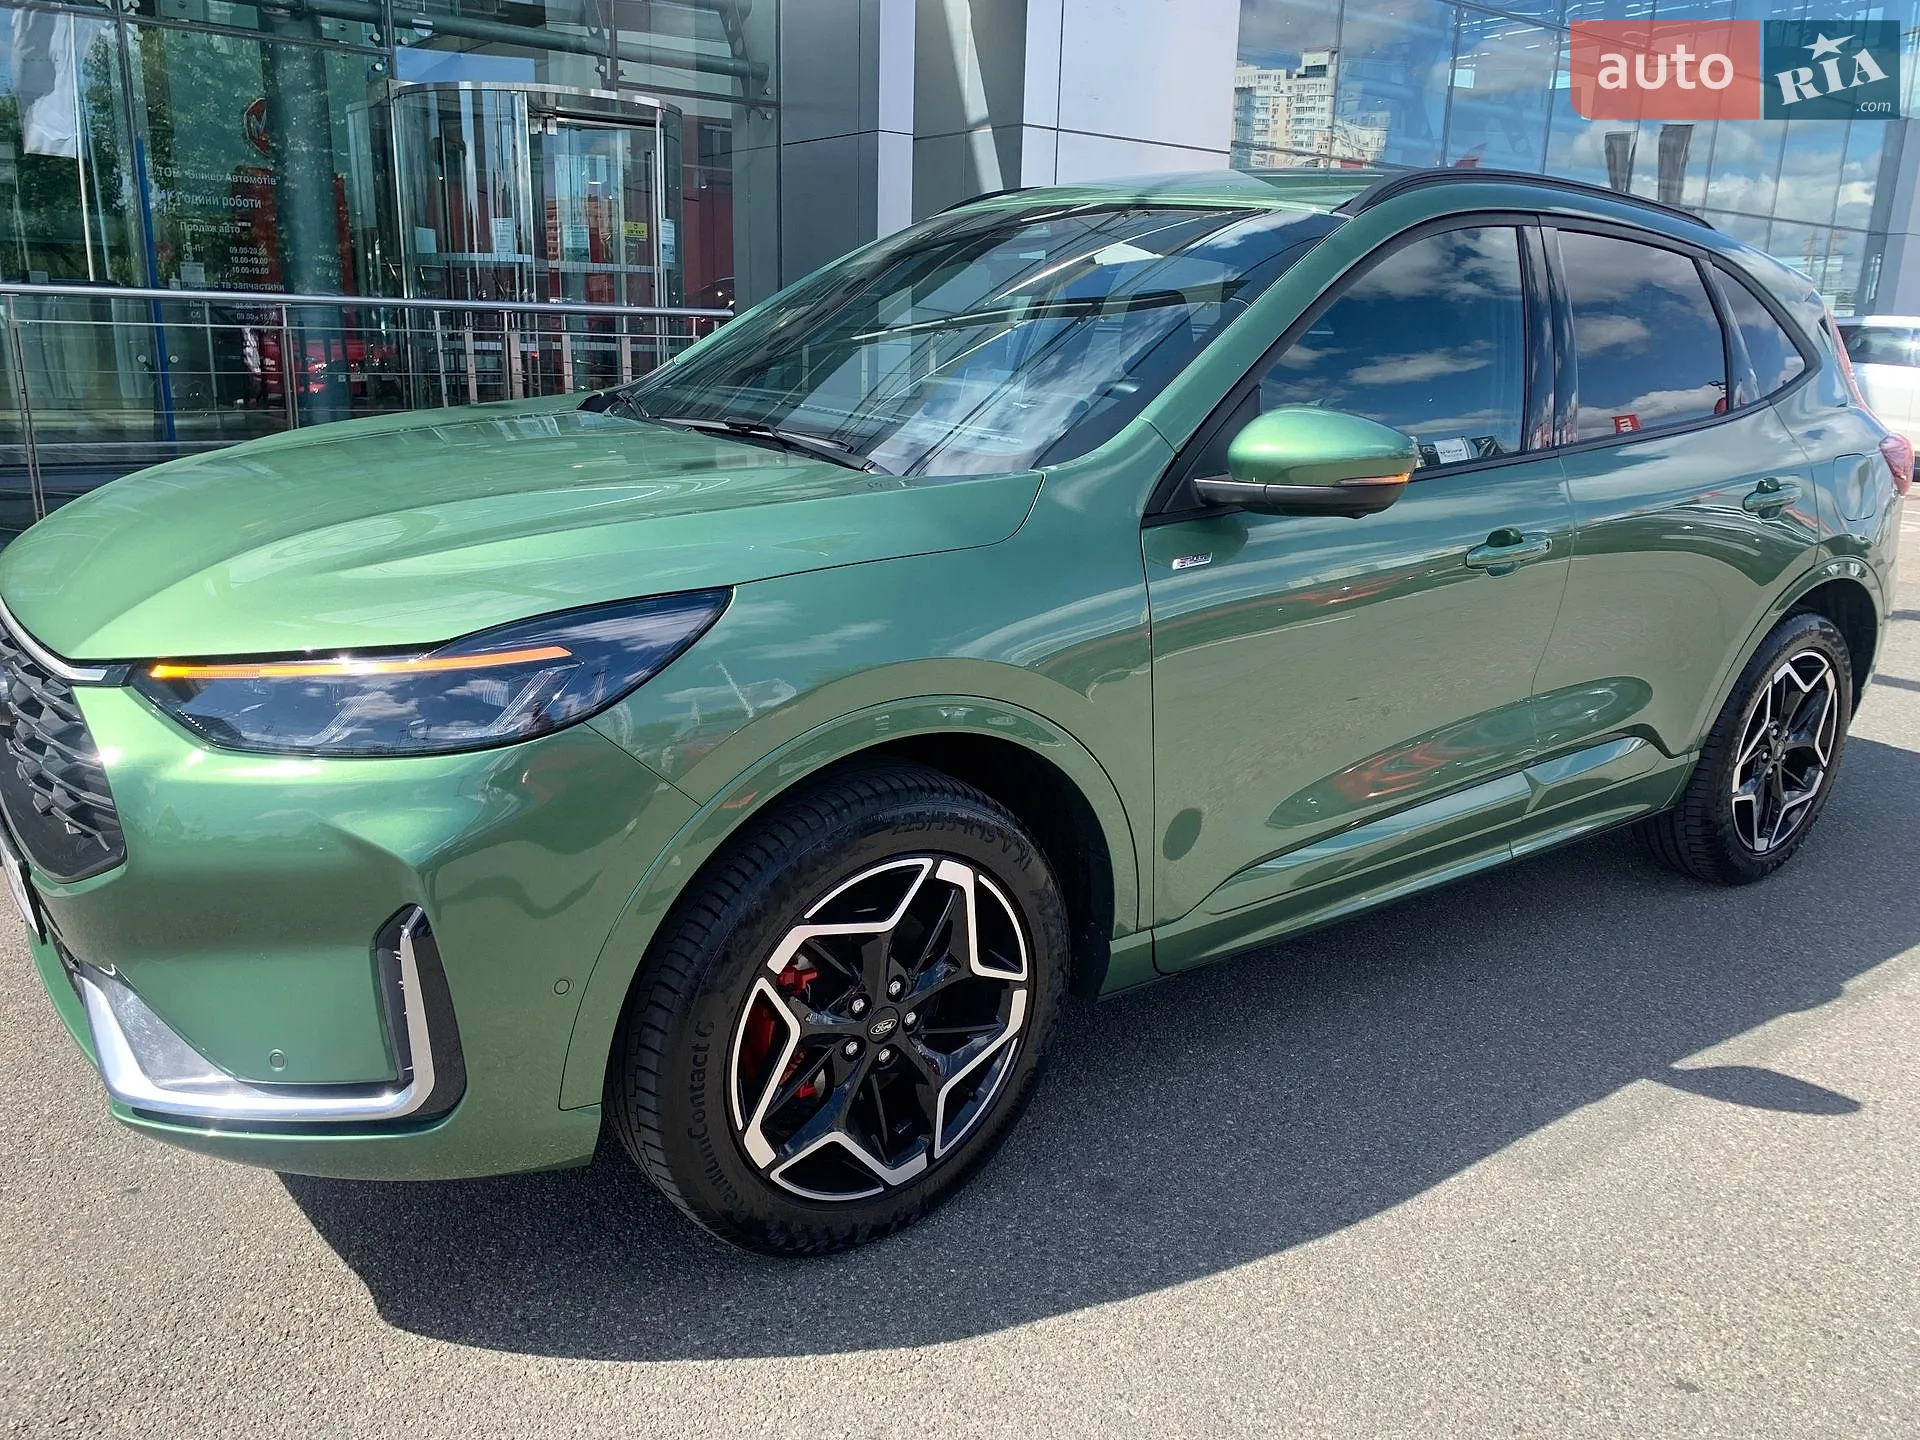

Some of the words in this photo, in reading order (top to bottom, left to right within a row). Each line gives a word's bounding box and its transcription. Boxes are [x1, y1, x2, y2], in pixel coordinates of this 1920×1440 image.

[222, 194, 262, 209] роботи
[180, 220, 217, 234] Продаж
[870, 1020, 895, 1034] Ford
